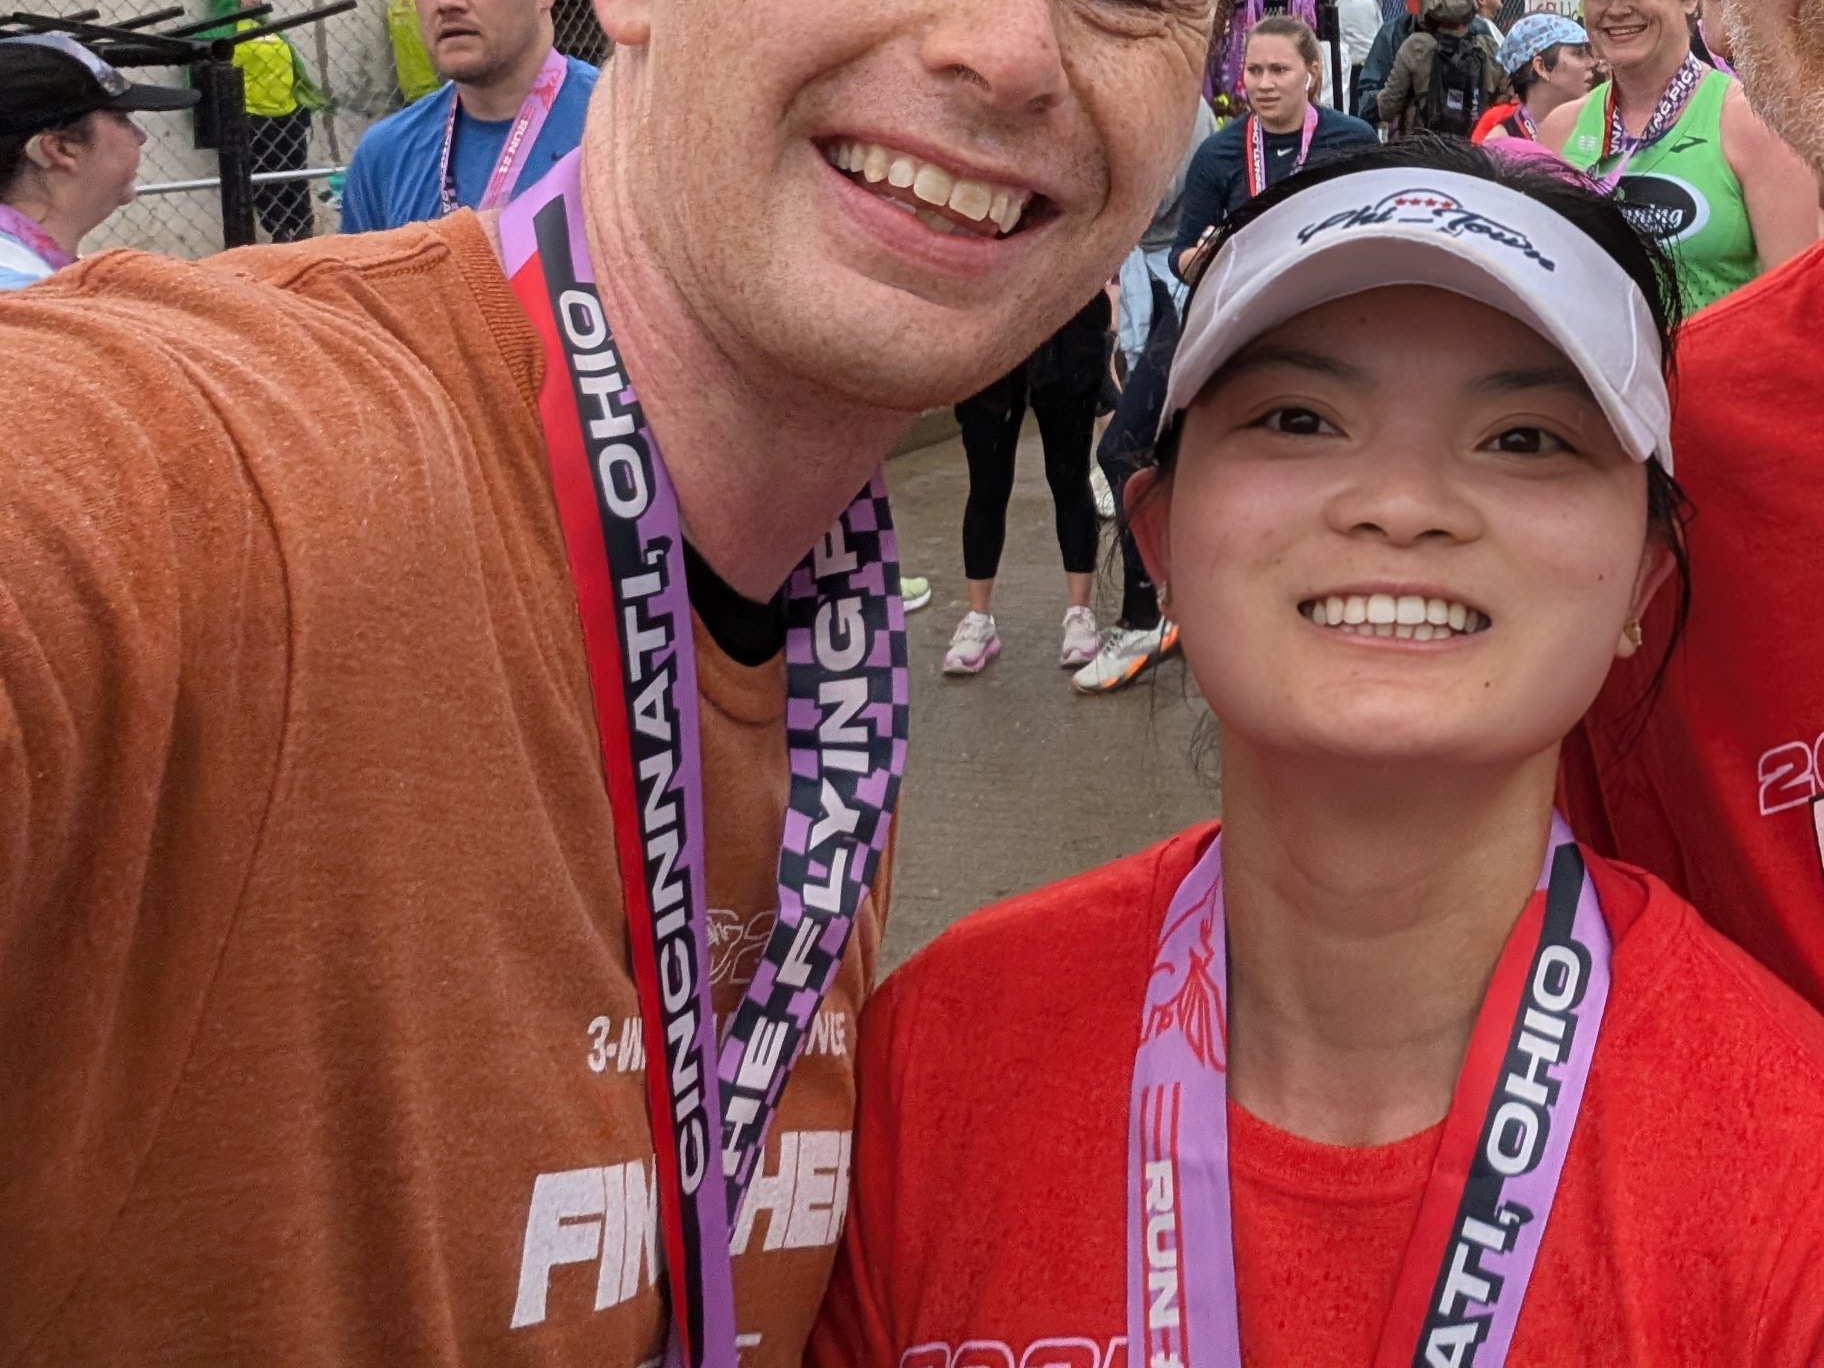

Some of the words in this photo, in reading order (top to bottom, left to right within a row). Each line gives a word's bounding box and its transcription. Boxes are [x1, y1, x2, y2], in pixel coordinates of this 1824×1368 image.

[508, 119, 529, 155] RUN
[1669, 69, 1694, 102] PIG
[559, 289, 648, 519] OHIO
[621, 548, 706, 1194] CINCINNATI,
[721, 1016, 790, 1176] HE
[776, 596, 870, 988] FLYING
[587, 1016, 646, 1073] 3-W
[1486, 944, 1581, 1175] OHIO
[510, 1131, 854, 1330] FINHE
[1145, 1158, 1181, 1329] RUN
